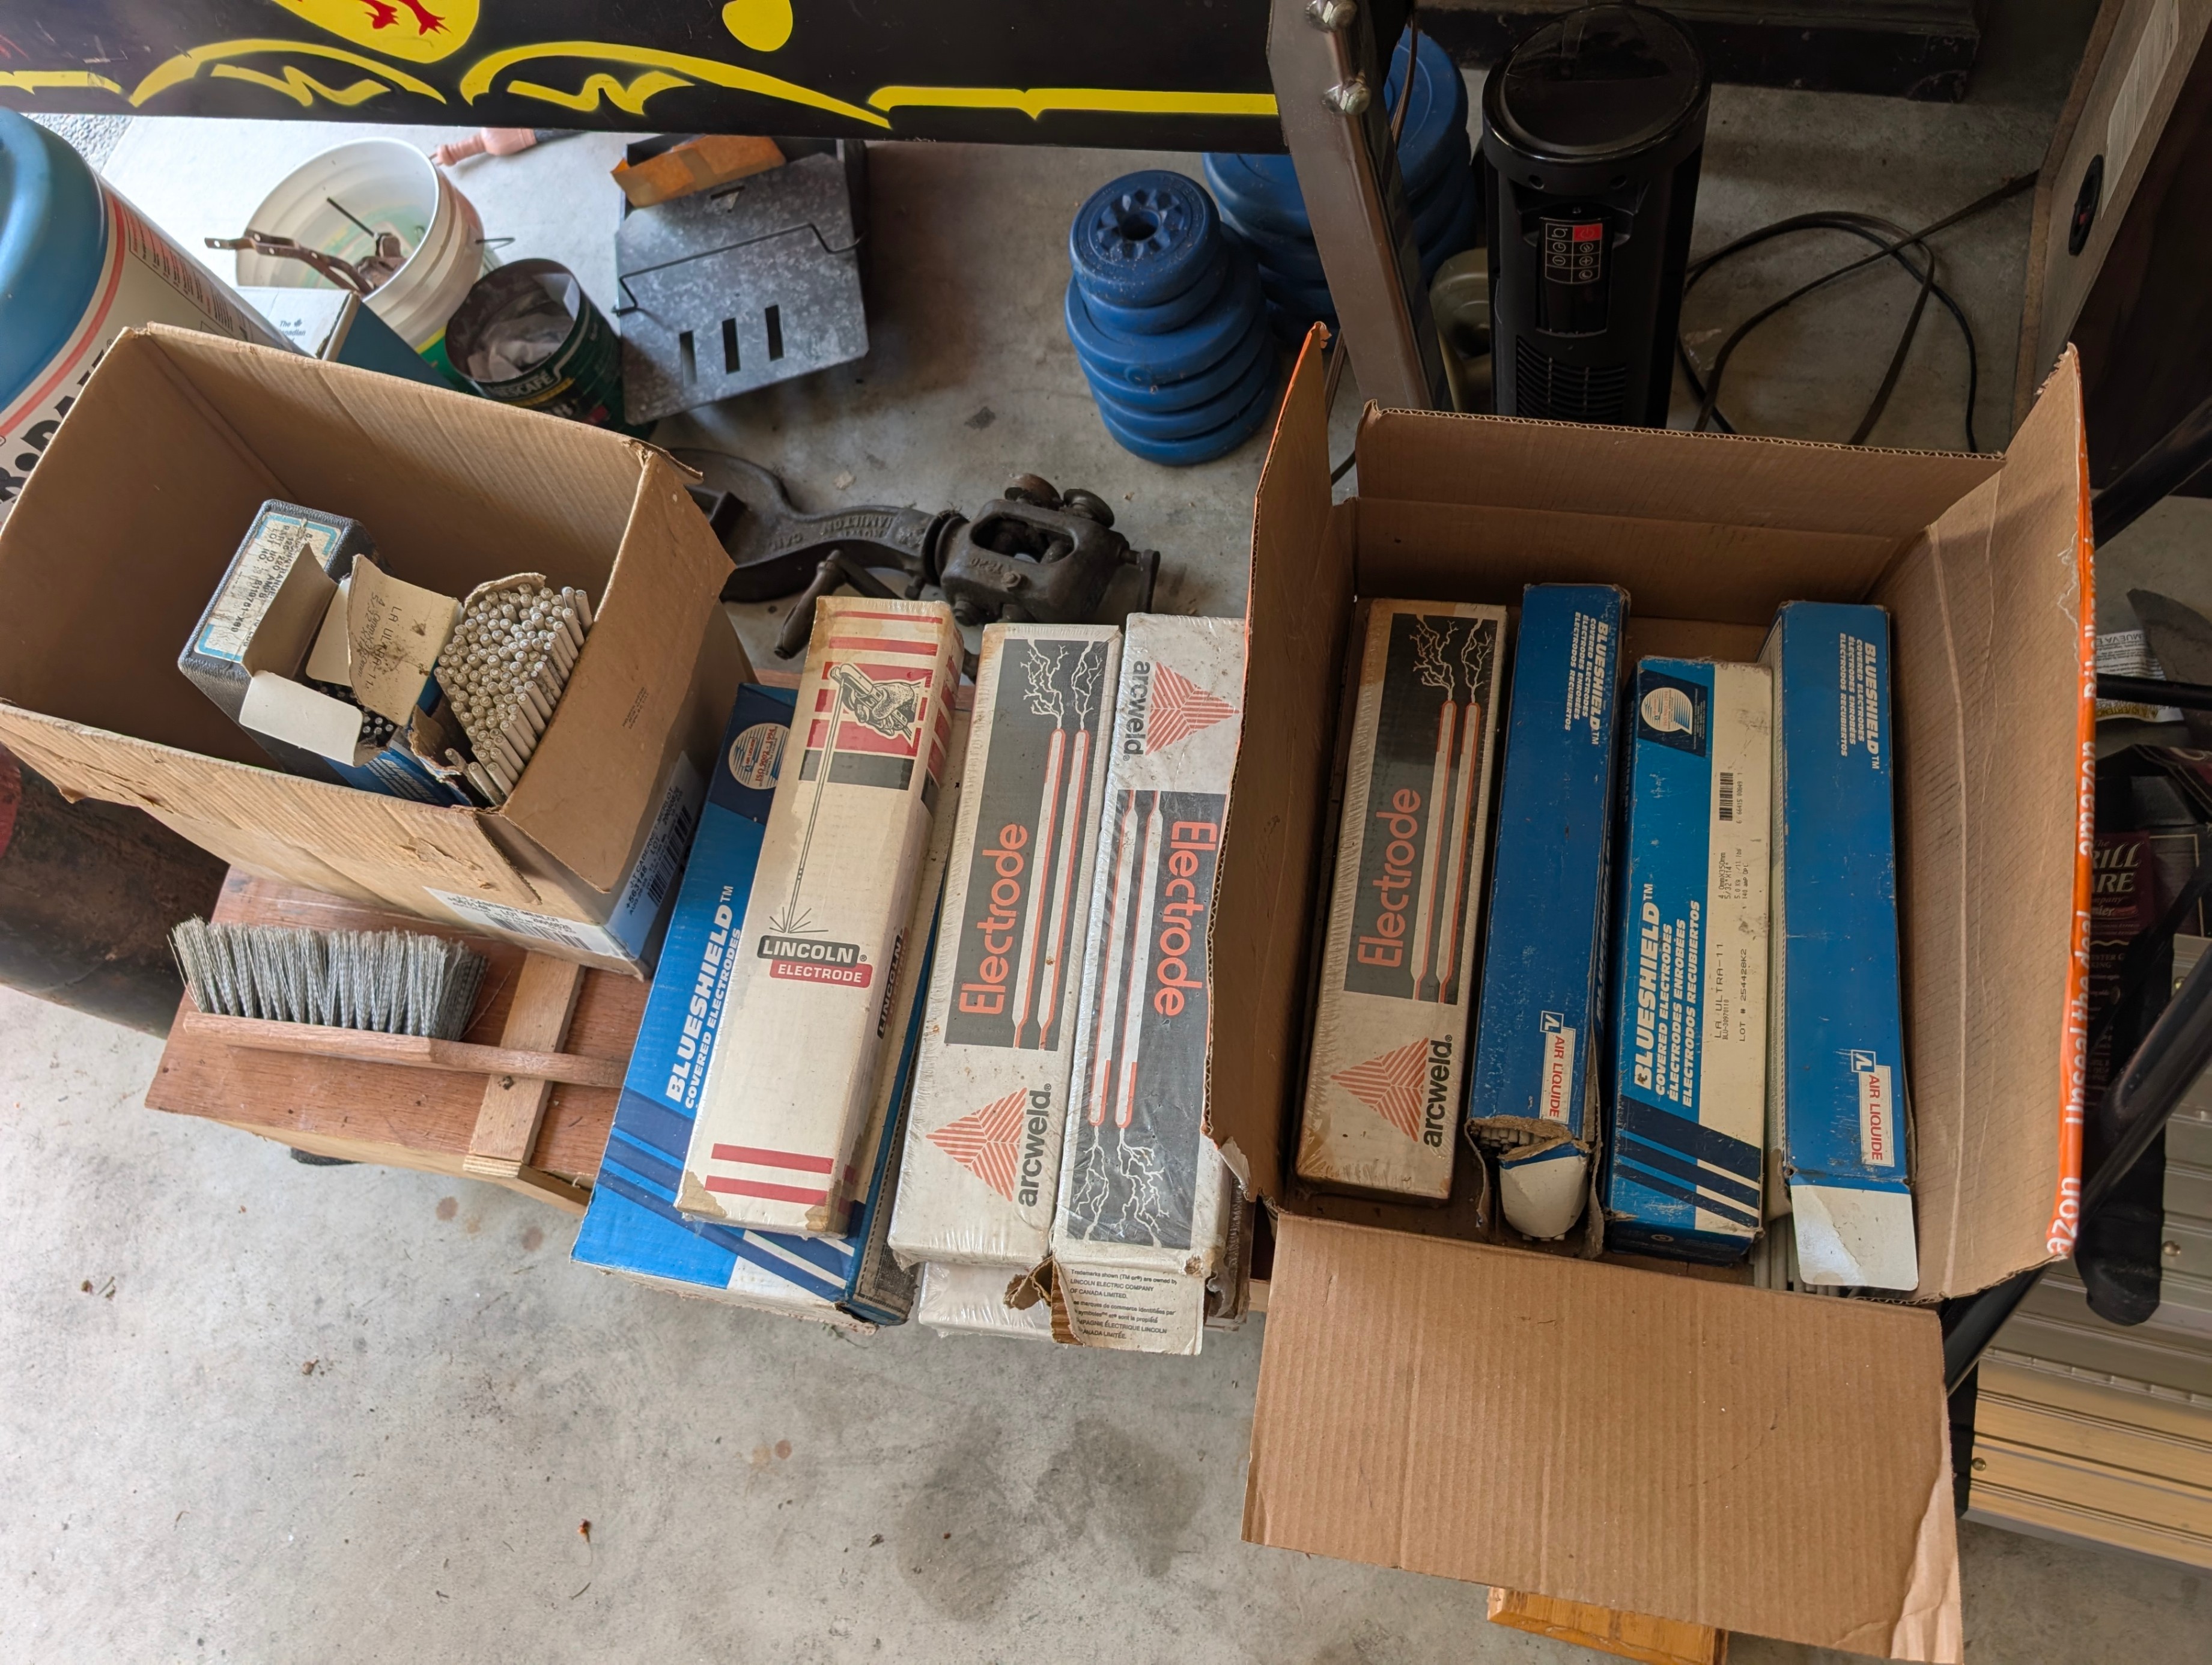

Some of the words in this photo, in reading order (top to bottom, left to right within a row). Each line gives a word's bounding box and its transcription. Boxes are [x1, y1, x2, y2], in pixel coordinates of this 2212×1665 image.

[387, 605, 402, 622] LA
[1570, 611, 1581, 668] ELECTRODOS
[1578, 614, 1590, 670] ÉLECTRODES
[1587, 617, 1597, 659] COVERED
[1564, 669, 1576, 731] RECUBIERTOS
[1574, 672, 1584, 720] ENROBÉES
[1582, 661, 1593, 717] ELECTRODES
[649, 835, 660, 855] LOT
[1357, 787, 1421, 968] Electrode
[959, 824, 1028, 1014] Electrode
[1154, 820, 1218, 1016] Electrode
[778, 964, 862, 982] ELECTRODE
[1659, 923, 1673, 1020] ELECTRODES
[1673, 918, 1686, 1000] ENROBÉES
[1687, 900, 1700, 1004] RECUBIERTOS
[1712, 942, 1727, 1011] ULTRA-11
[1737, 947, 1749, 1001] 254428K2
[880, 941, 902, 1033] LINCOLN
[684, 1031, 714, 1110] COVERED
[705, 927, 743, 1030] ELECTRODES
[1714, 1020, 1722, 1038] LA
[1738, 1021, 1746, 1042] LOT
[1554, 1036, 1565, 1059] AIR
[1656, 1022, 1668, 1096] COVERED
[1667, 1002, 1683, 1102] ÉLECTRODES
[1683, 1005, 1696, 1108] ELECTRODOS
[1549, 1063, 1563, 1118] LIQUIDE
[1868, 1075, 1880, 1099] AIR
[1870, 1103, 1883, 1160] LIQUIDE
[1105, 1320, 1140, 1331] ÉLECTRIQUE
